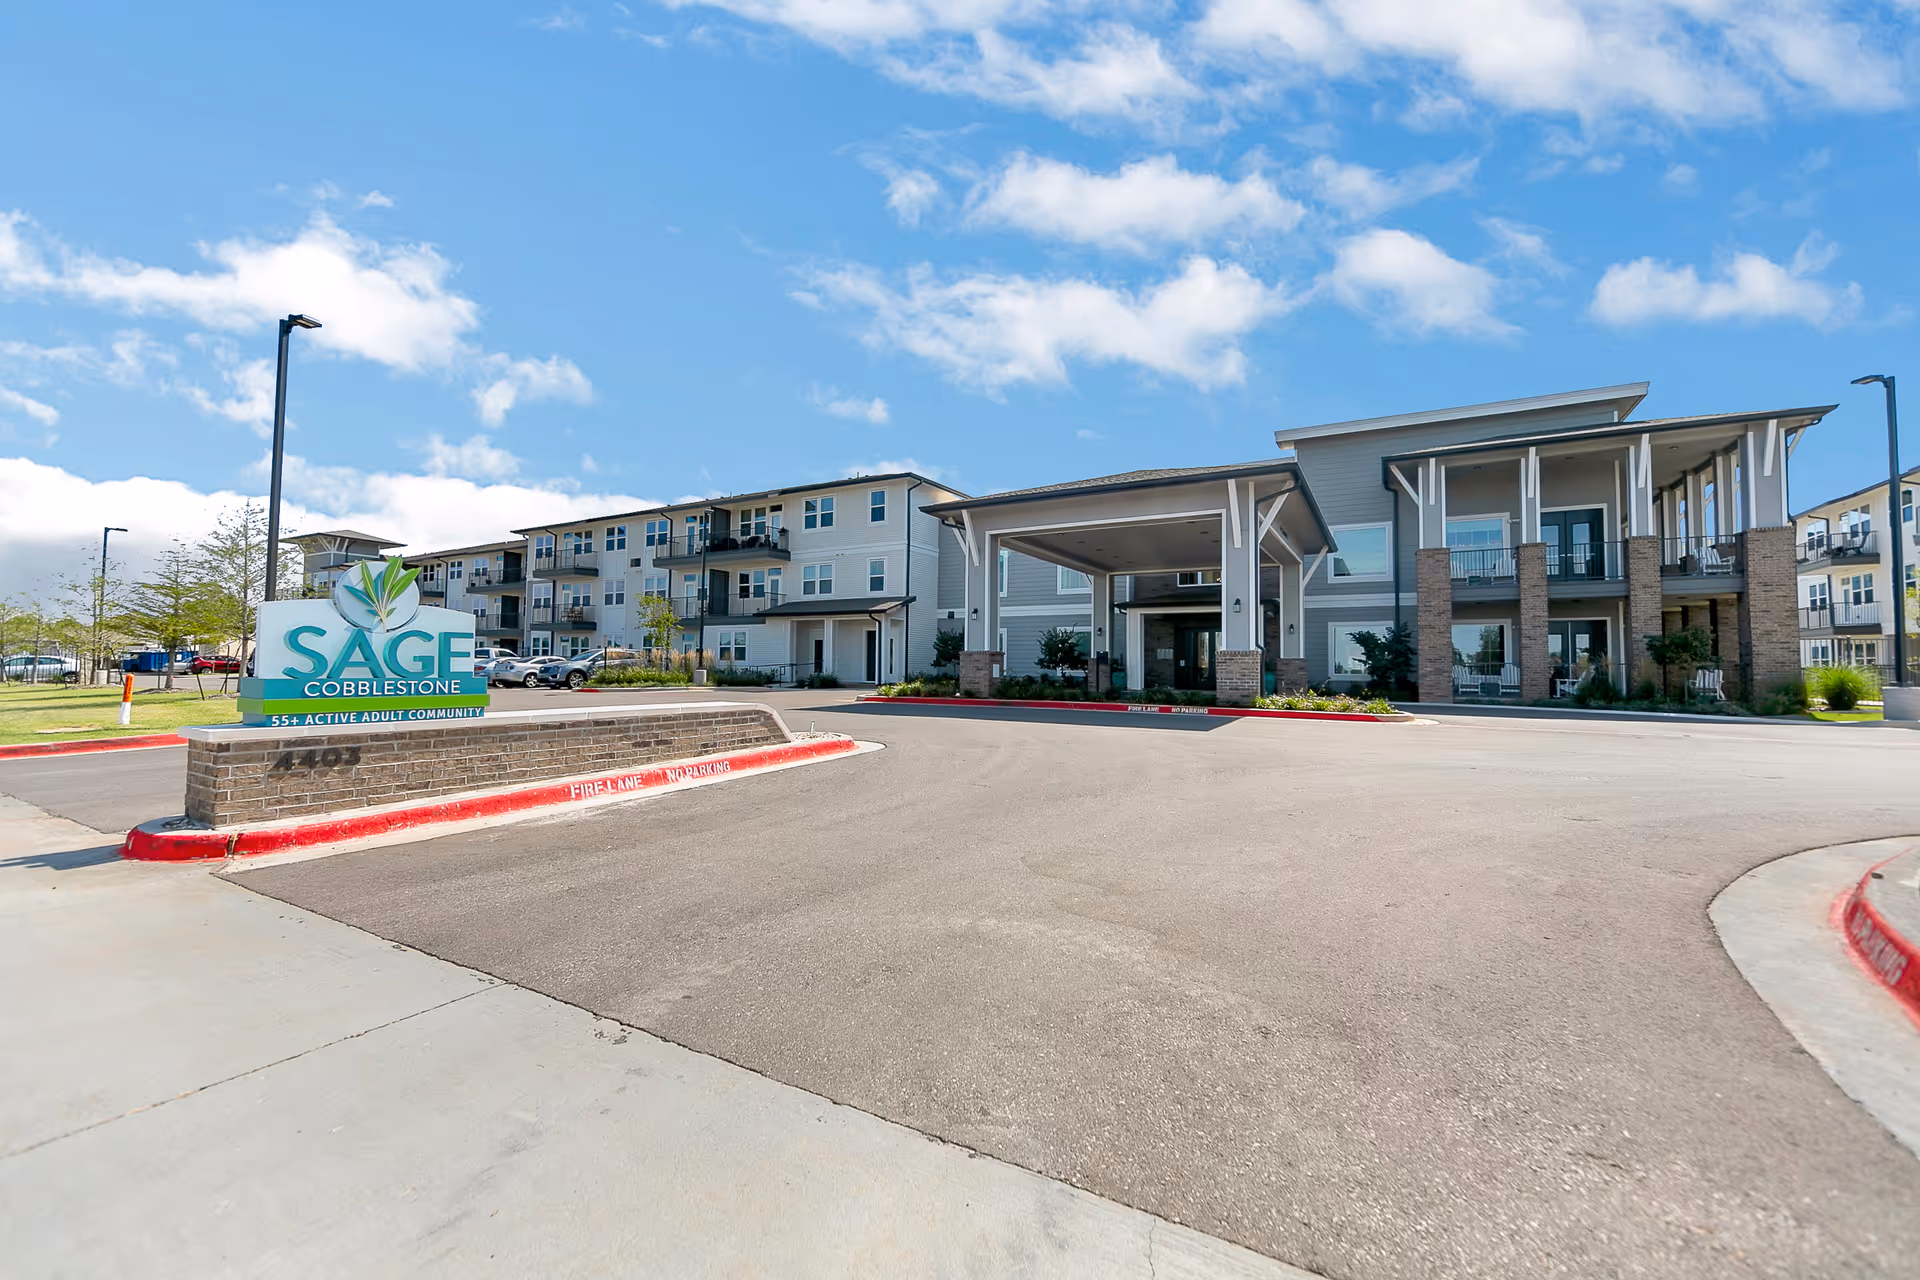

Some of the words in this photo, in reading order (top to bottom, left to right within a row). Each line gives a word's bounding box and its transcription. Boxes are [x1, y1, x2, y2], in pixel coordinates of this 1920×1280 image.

[282, 625, 475, 679] SAGE
[304, 679, 461, 697] COBBLESTONE
[271, 715, 299, 727] 55+
[304, 712, 357, 726] ACTIVE
[361, 710, 404, 723] ADULT
[408, 707, 482, 721] COMMUNITY
[272, 746, 362, 771] 4403
[570, 780, 603, 800] FIRE
[606, 775, 642, 796] LANE
[665, 768, 684, 782] NO
[685, 760, 731, 780] PARKING
